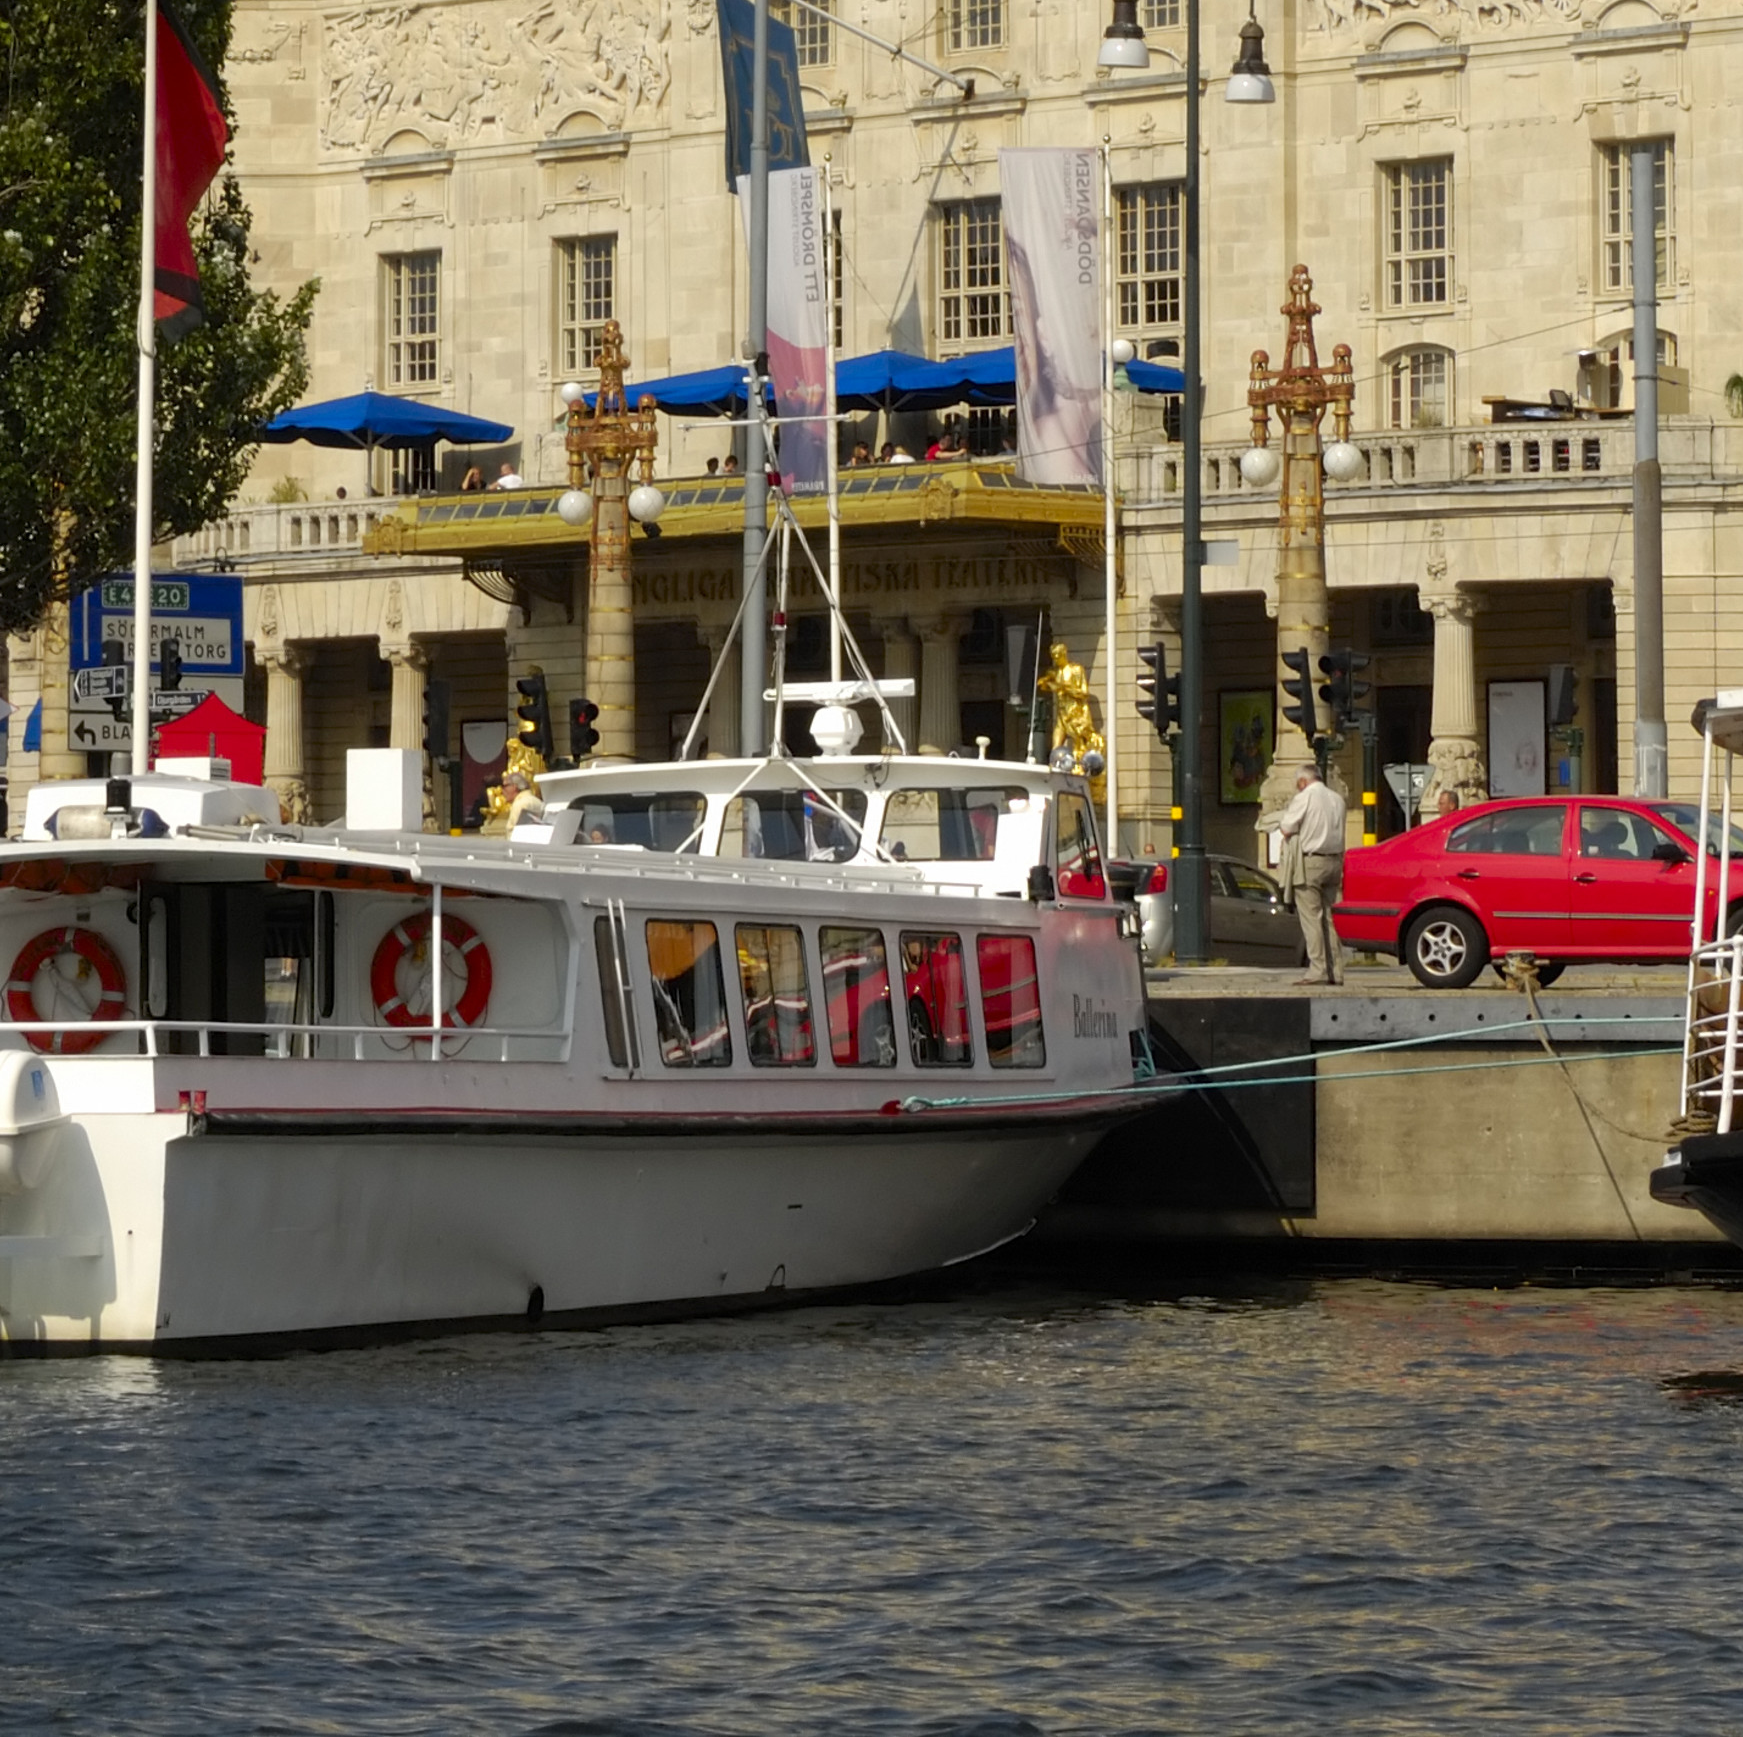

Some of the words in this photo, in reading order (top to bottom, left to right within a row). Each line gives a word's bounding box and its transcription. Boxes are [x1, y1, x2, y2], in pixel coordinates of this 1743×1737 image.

[632, 568, 734, 605] NGLIGA
[107, 620, 205, 640] SÖRMALM
[185, 643, 226, 659] TORG
[1073, 993, 1118, 1039] Ballerina
